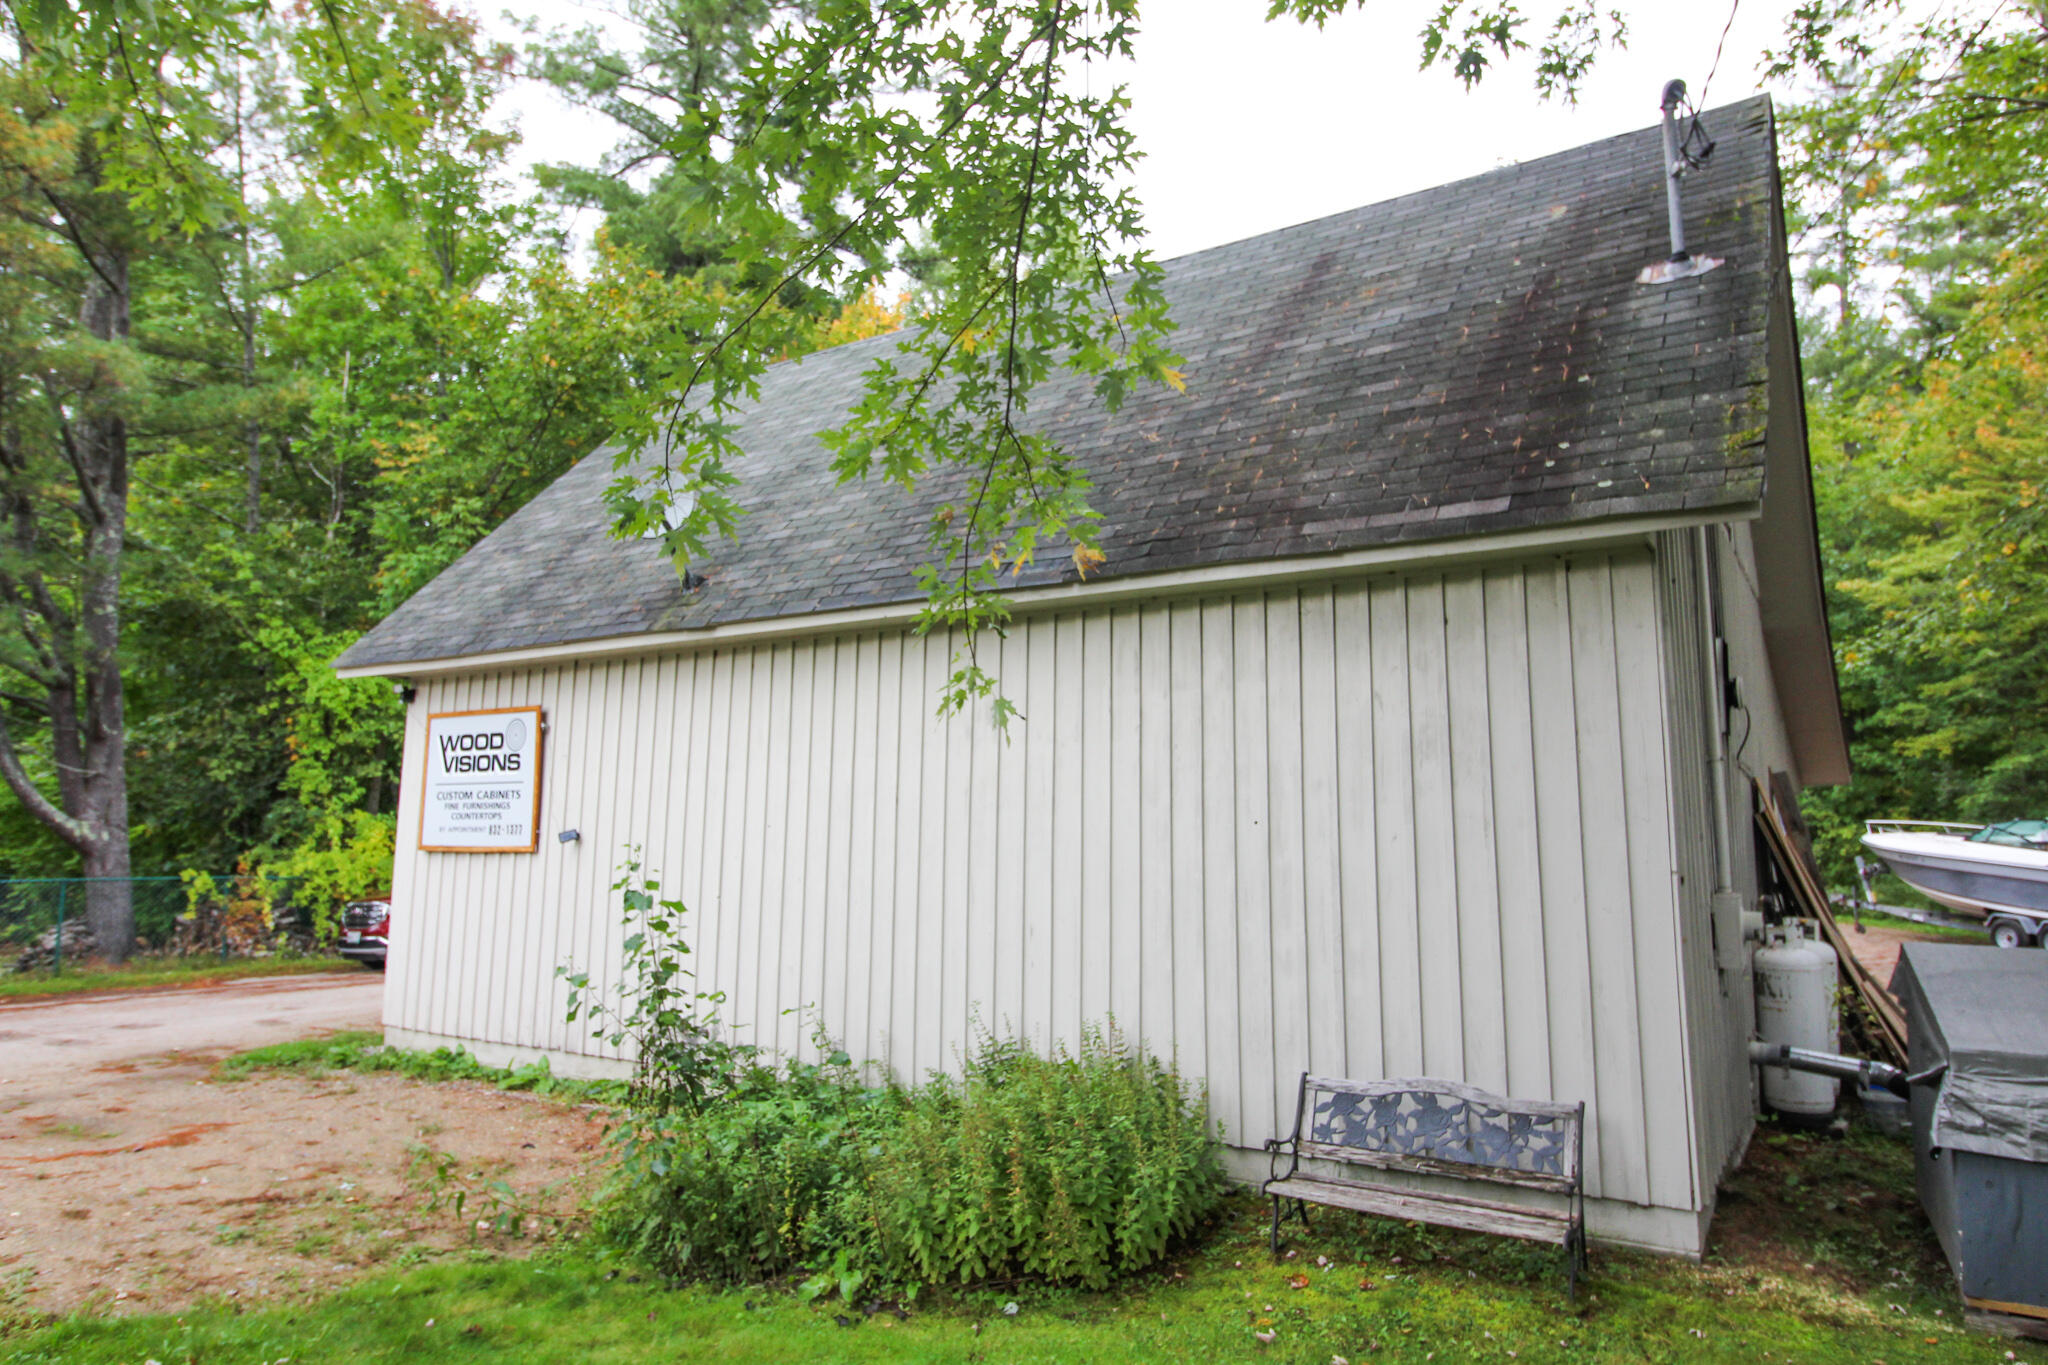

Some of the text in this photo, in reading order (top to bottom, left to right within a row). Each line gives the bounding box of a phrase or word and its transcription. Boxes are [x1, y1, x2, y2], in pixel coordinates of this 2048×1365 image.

[439, 733, 504, 752] WOOD
[442, 753, 521, 773] VISIONS
[436, 790, 521, 800] CUSTOM CABINETS
[451, 812, 502, 820] COUNTERTOPS
